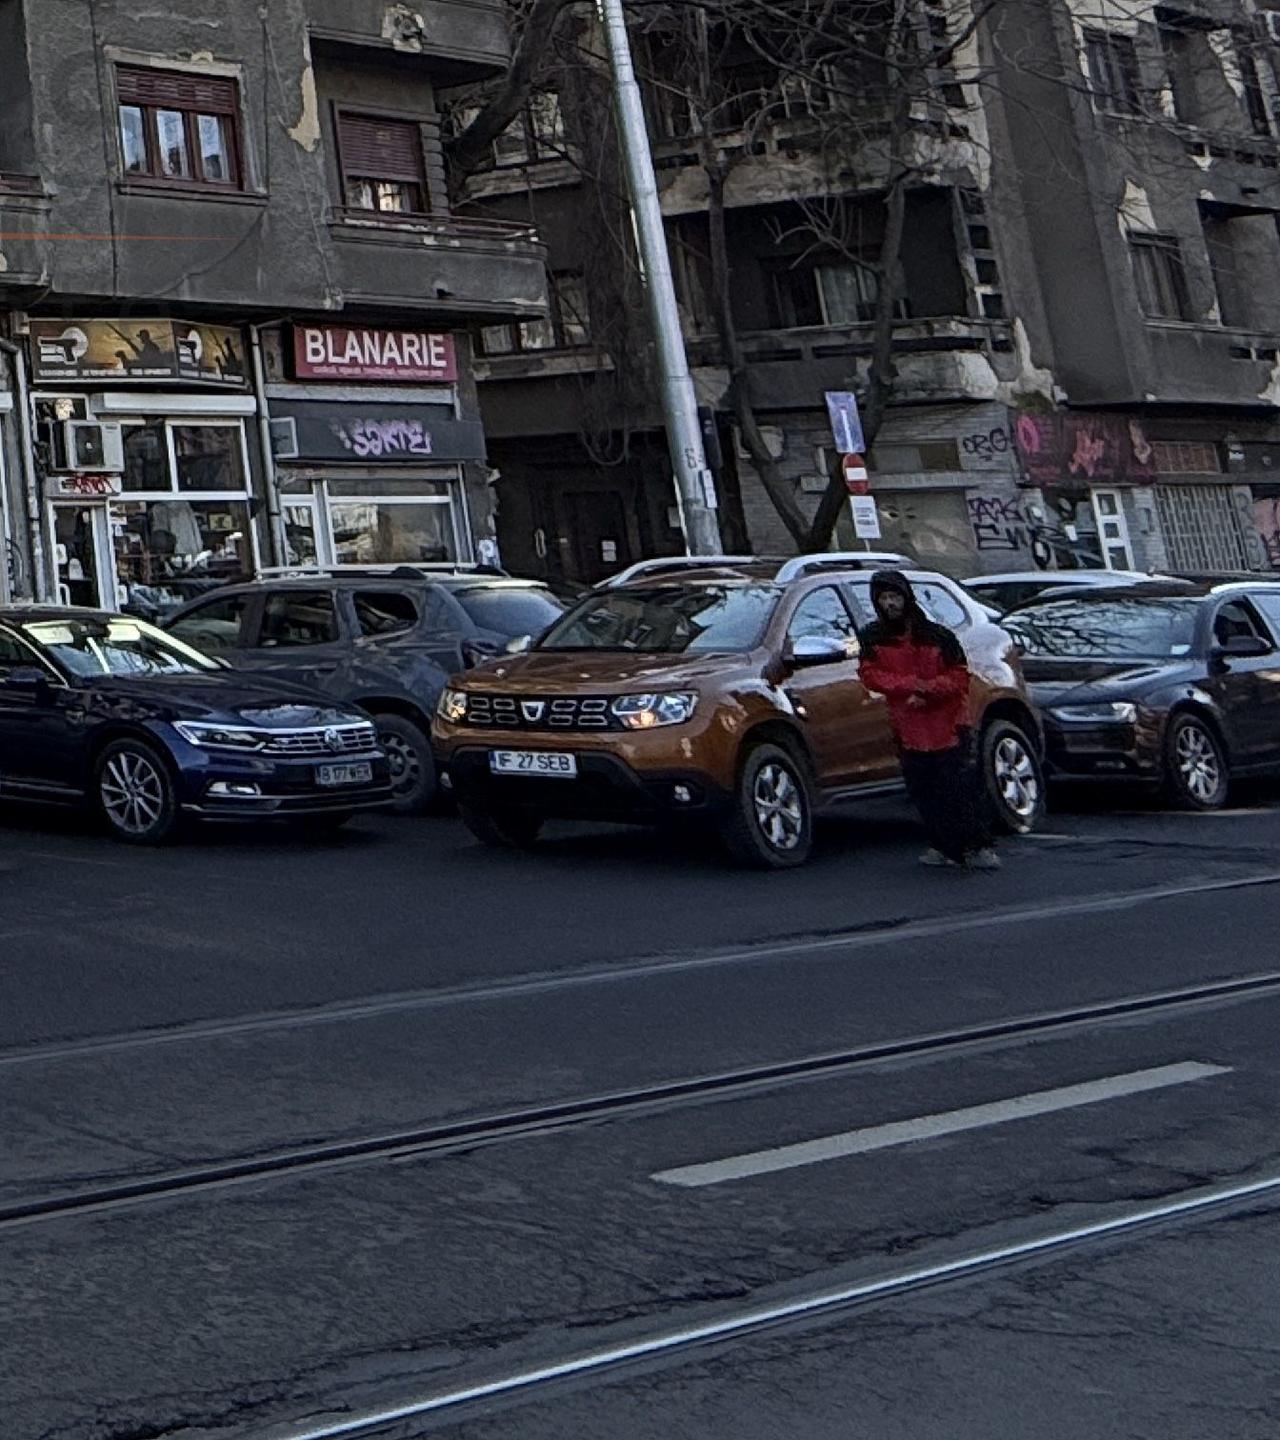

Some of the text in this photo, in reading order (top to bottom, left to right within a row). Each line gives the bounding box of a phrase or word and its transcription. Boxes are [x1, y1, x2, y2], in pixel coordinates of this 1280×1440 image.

[305, 329, 447, 367] BLANARIE
[517, 753, 534, 768] 27
[537, 754, 571, 771] SEB
